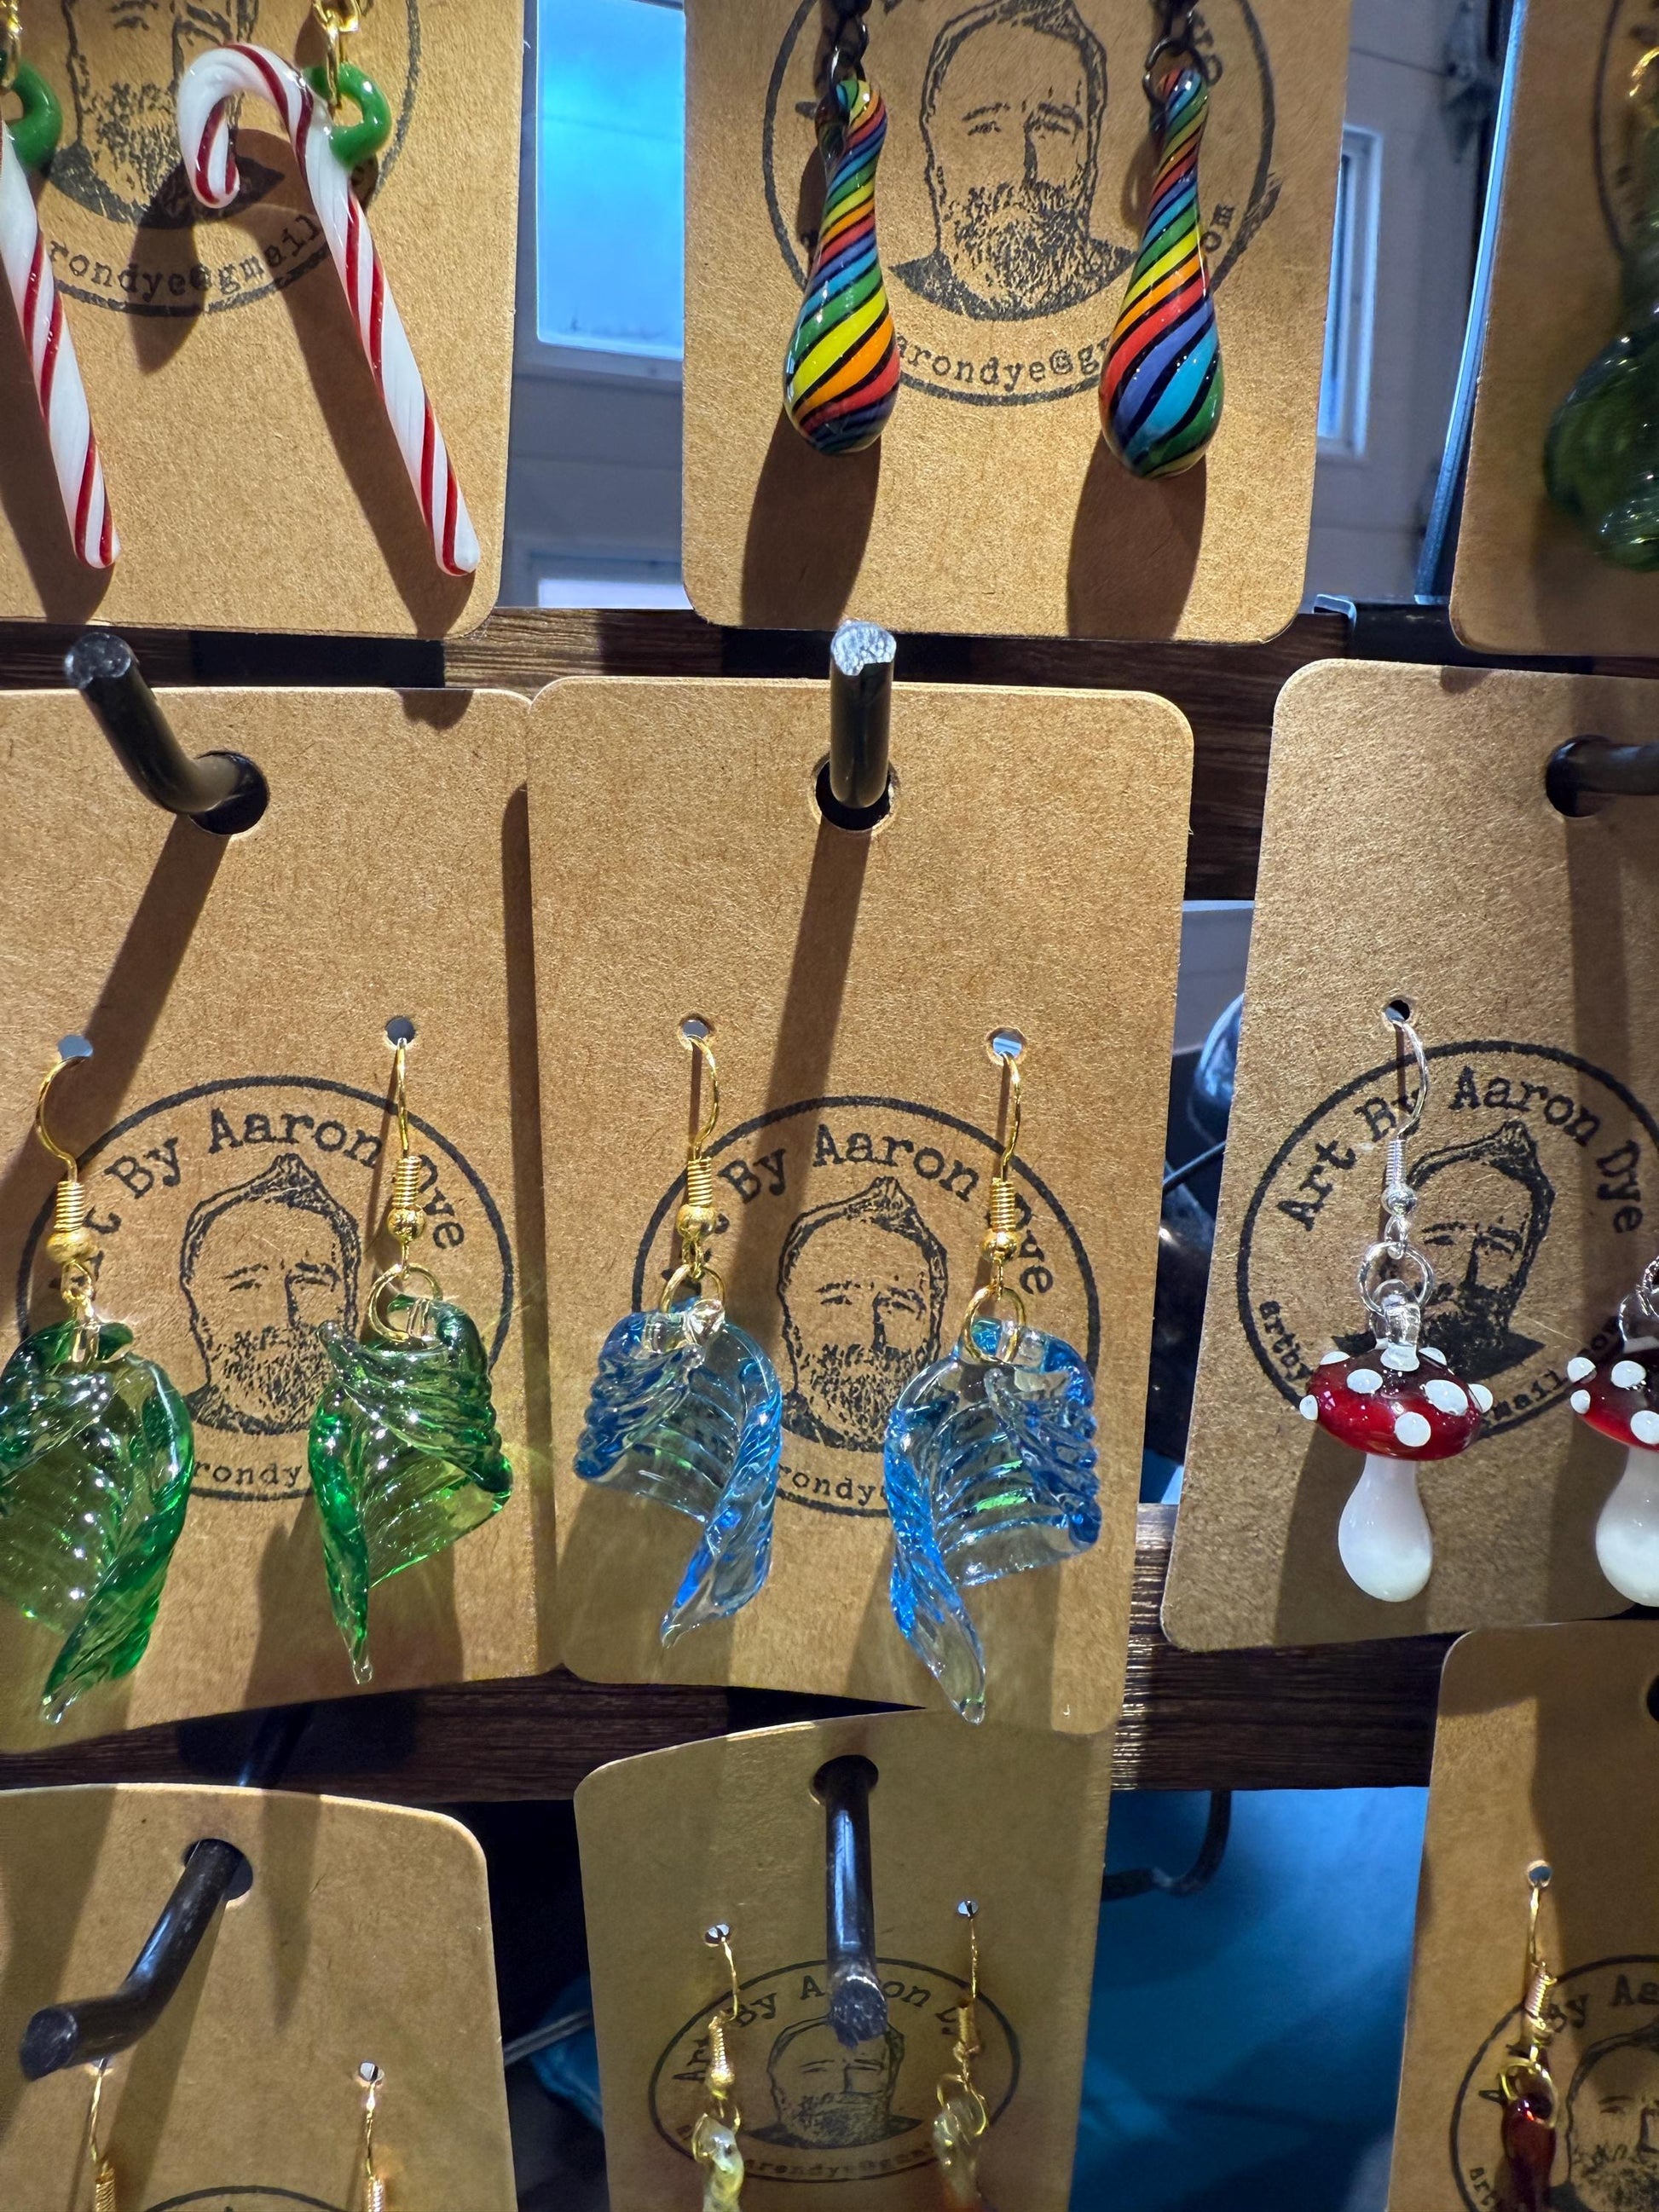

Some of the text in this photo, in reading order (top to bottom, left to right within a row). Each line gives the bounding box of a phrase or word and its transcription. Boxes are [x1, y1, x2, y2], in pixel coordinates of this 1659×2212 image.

[106, 1137, 182, 1199] By
[208, 1108, 384, 1168] Aaron
[717, 1148, 787, 1204] By
[812, 1123, 980, 1202] Aaron
[1278, 1140, 1357, 1232] Art
[1449, 1066, 1601, 1148] Aaron
[1596, 1140, 1644, 1234] Dye
[800, 1974, 931, 2008] Aon
